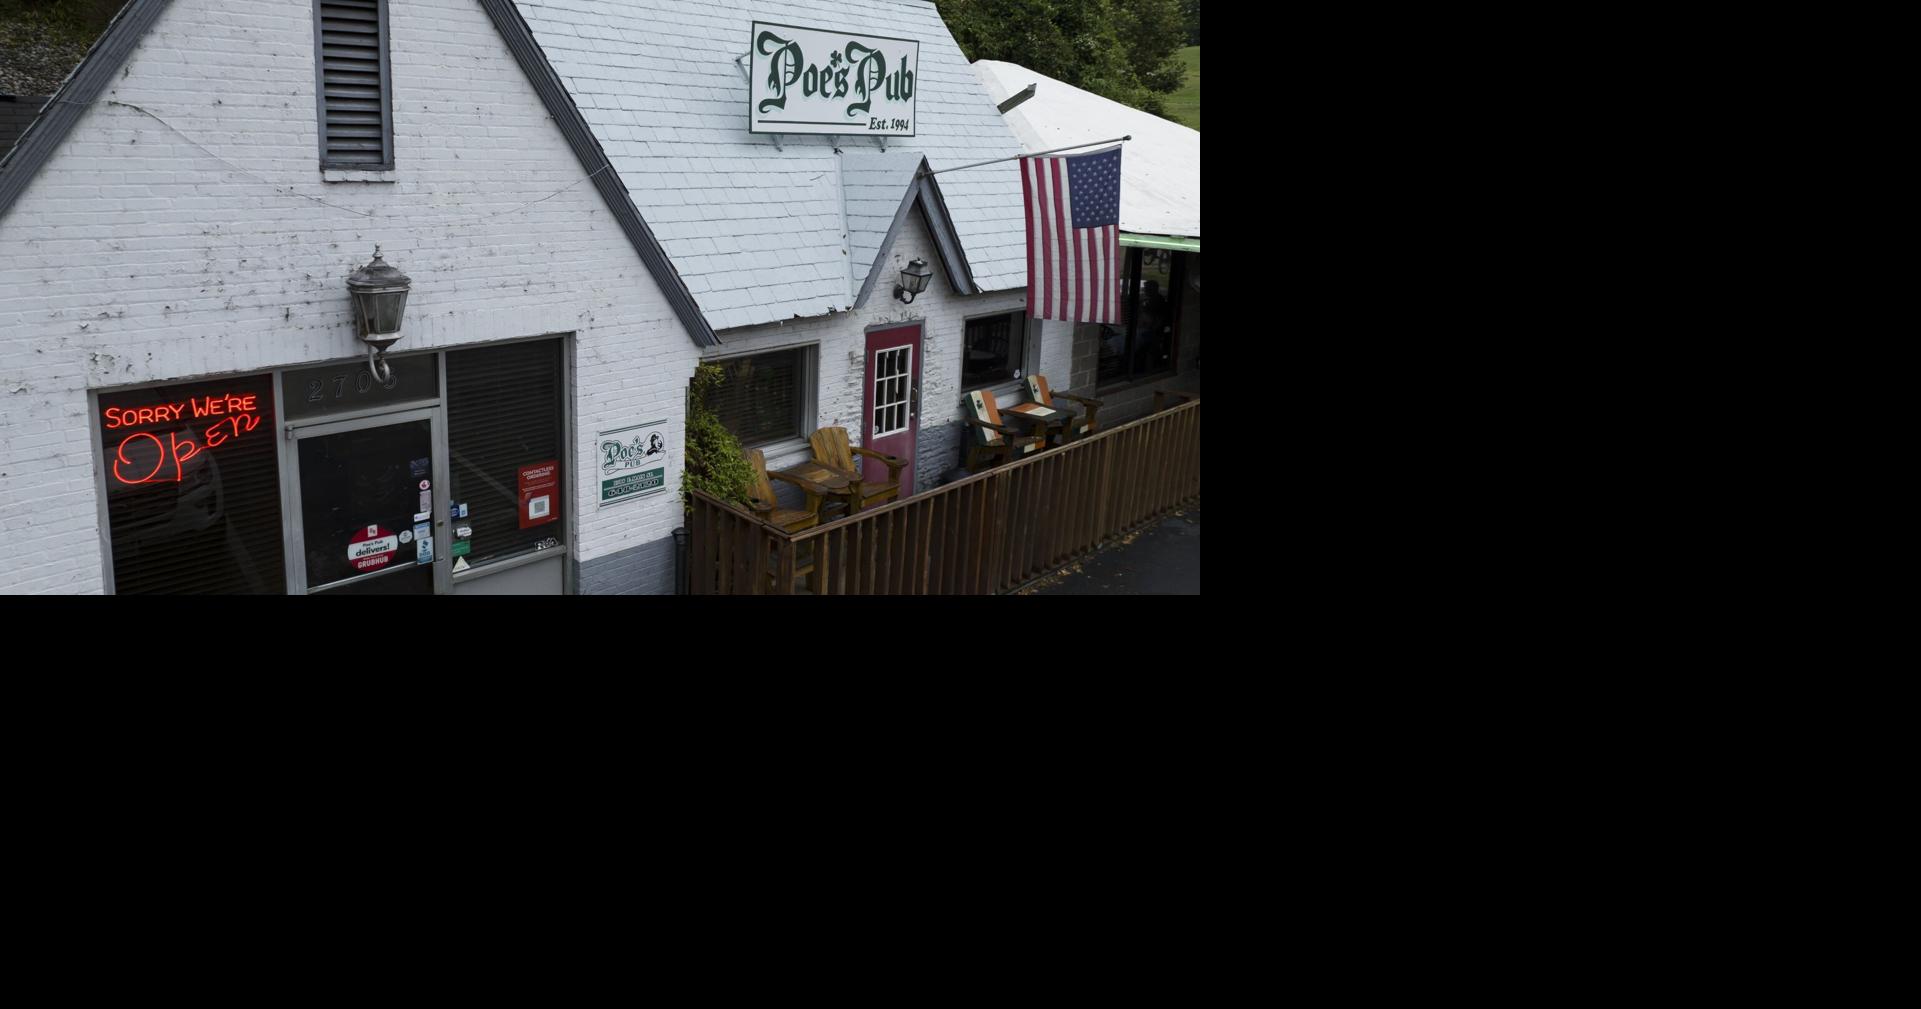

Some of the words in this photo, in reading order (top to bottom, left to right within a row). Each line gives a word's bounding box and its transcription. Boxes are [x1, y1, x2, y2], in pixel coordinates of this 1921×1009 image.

[845, 41, 914, 117] Pub
[869, 117, 889, 131] Est.
[890, 118, 910, 131] 1994
[105, 403, 185, 429] SORRY
[113, 414, 261, 484] Open
[522, 466, 554, 477] CONTACTLESS
[355, 543, 390, 557] delivers!
[357, 555, 389, 569] GRUBHUB
